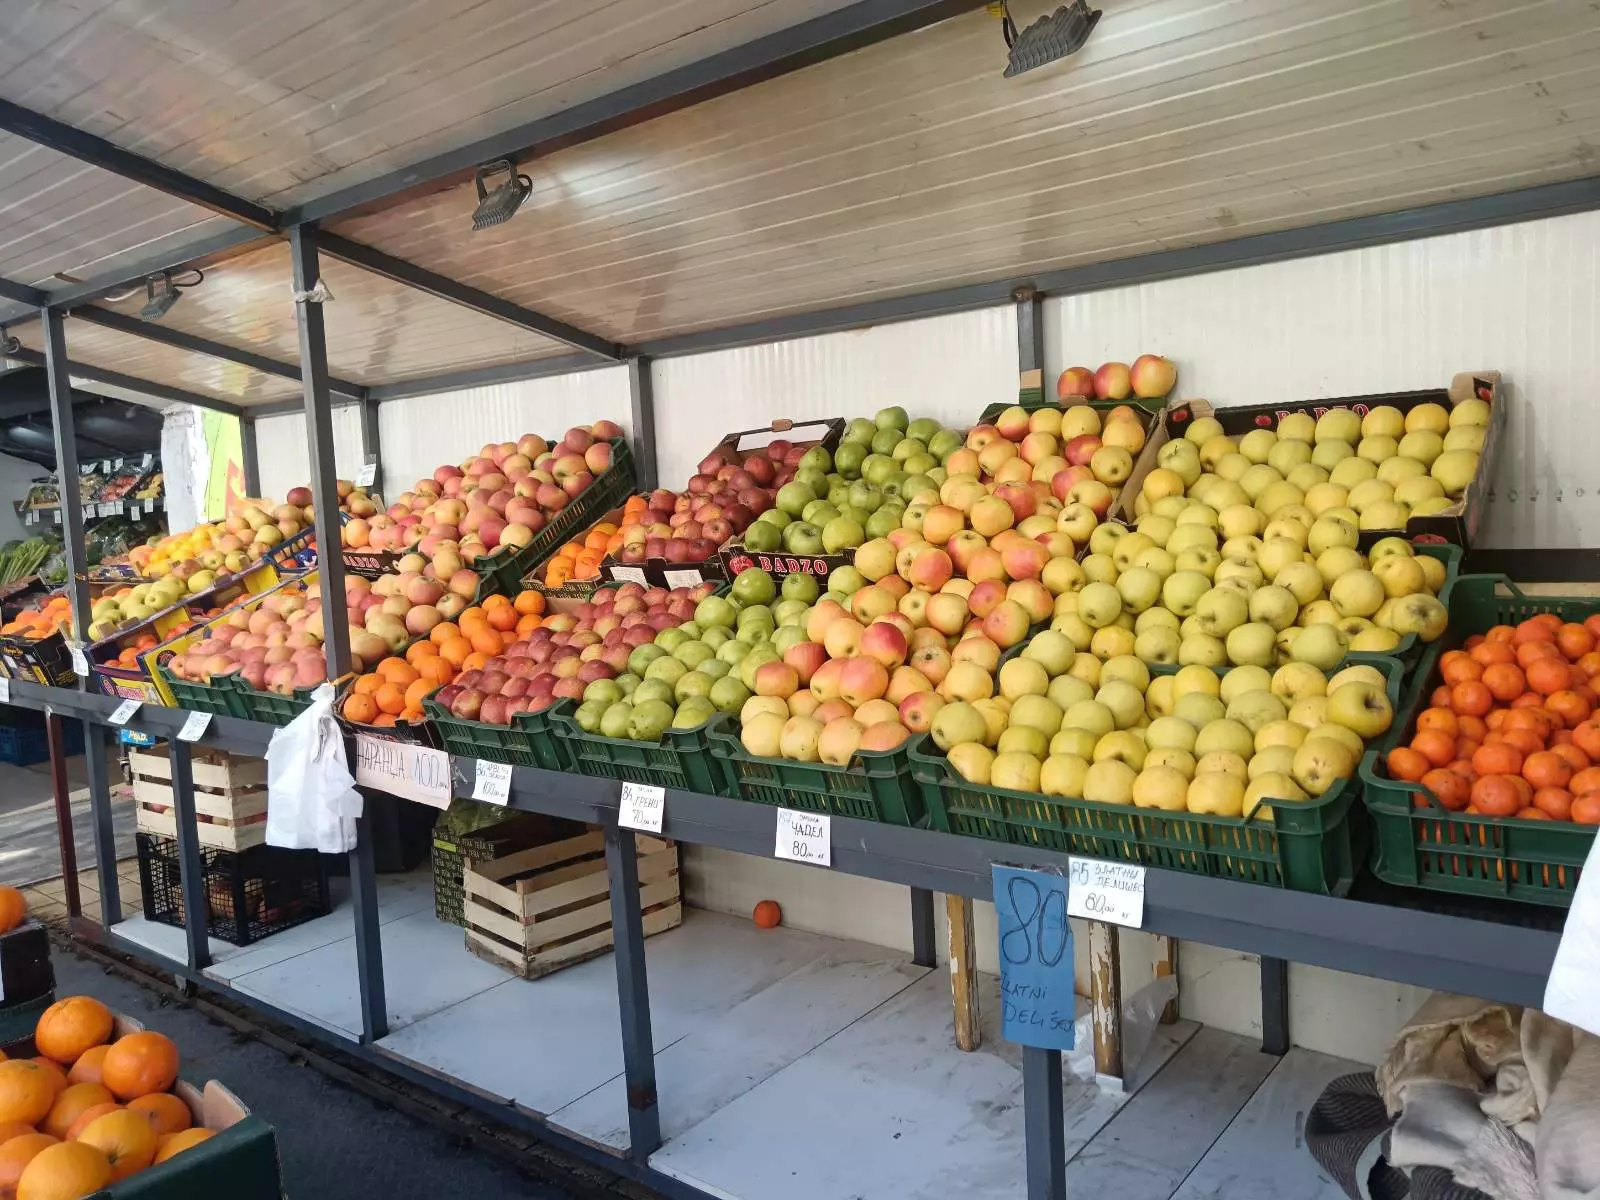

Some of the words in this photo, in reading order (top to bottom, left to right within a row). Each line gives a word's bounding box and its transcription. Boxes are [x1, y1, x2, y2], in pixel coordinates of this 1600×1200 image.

[759, 556, 828, 575] BADZO
[792, 821, 823, 838] ЧАДЕЛ
[1071, 861, 1089, 886] 85
[1001, 876, 1069, 968] 80
